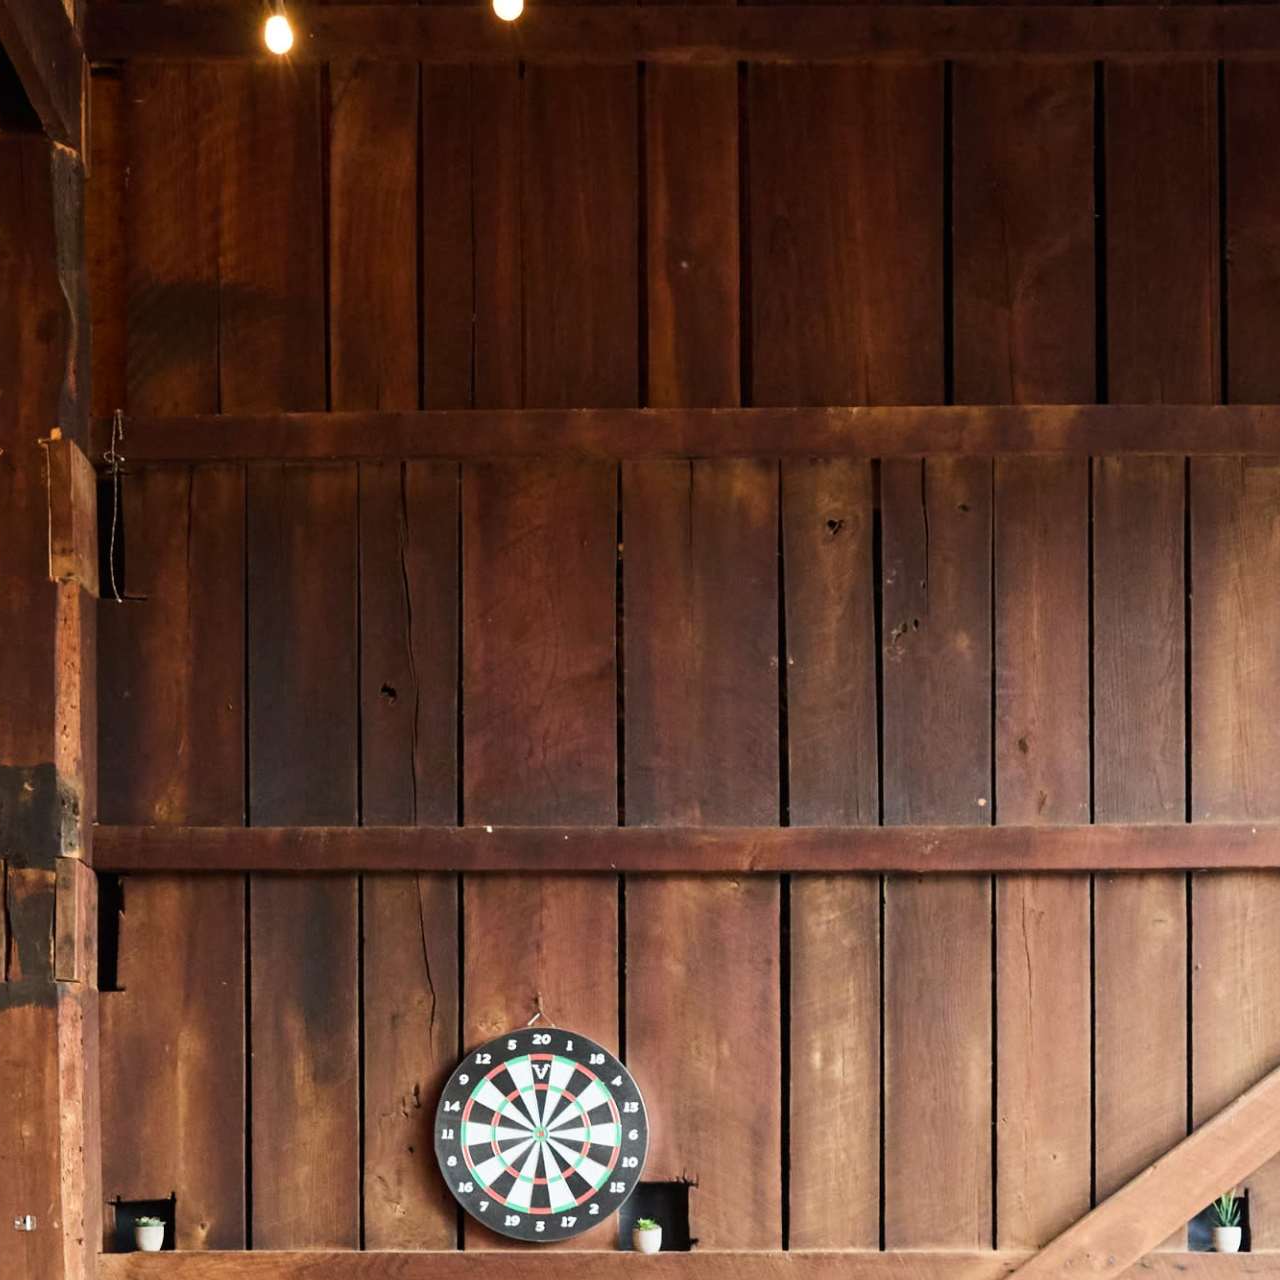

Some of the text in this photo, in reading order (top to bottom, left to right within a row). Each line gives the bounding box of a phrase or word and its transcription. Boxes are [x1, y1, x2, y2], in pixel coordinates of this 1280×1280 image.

[532, 1034, 551, 1044] 20
[508, 1040, 517, 1050] 5
[566, 1041, 572, 1051] 1
[476, 1054, 491, 1064] 12
[590, 1054, 605, 1064] 18
[459, 1074, 469, 1085] 9
[611, 1076, 622, 1086] 4
[444, 1101, 460, 1111] 14
[441, 1129, 454, 1139] 11
[628, 1129, 638, 1140] 6
[447, 1156, 457, 1166] 8
[622, 1157, 638, 1168] 10
[458, 1182, 473, 1192] 16
[610, 1182, 625, 1193] 15
[480, 1201, 489, 1211] 7
[589, 1204, 599, 1214] 2
[505, 1215, 520, 1226] 19
[561, 1216, 577, 1227] 17
